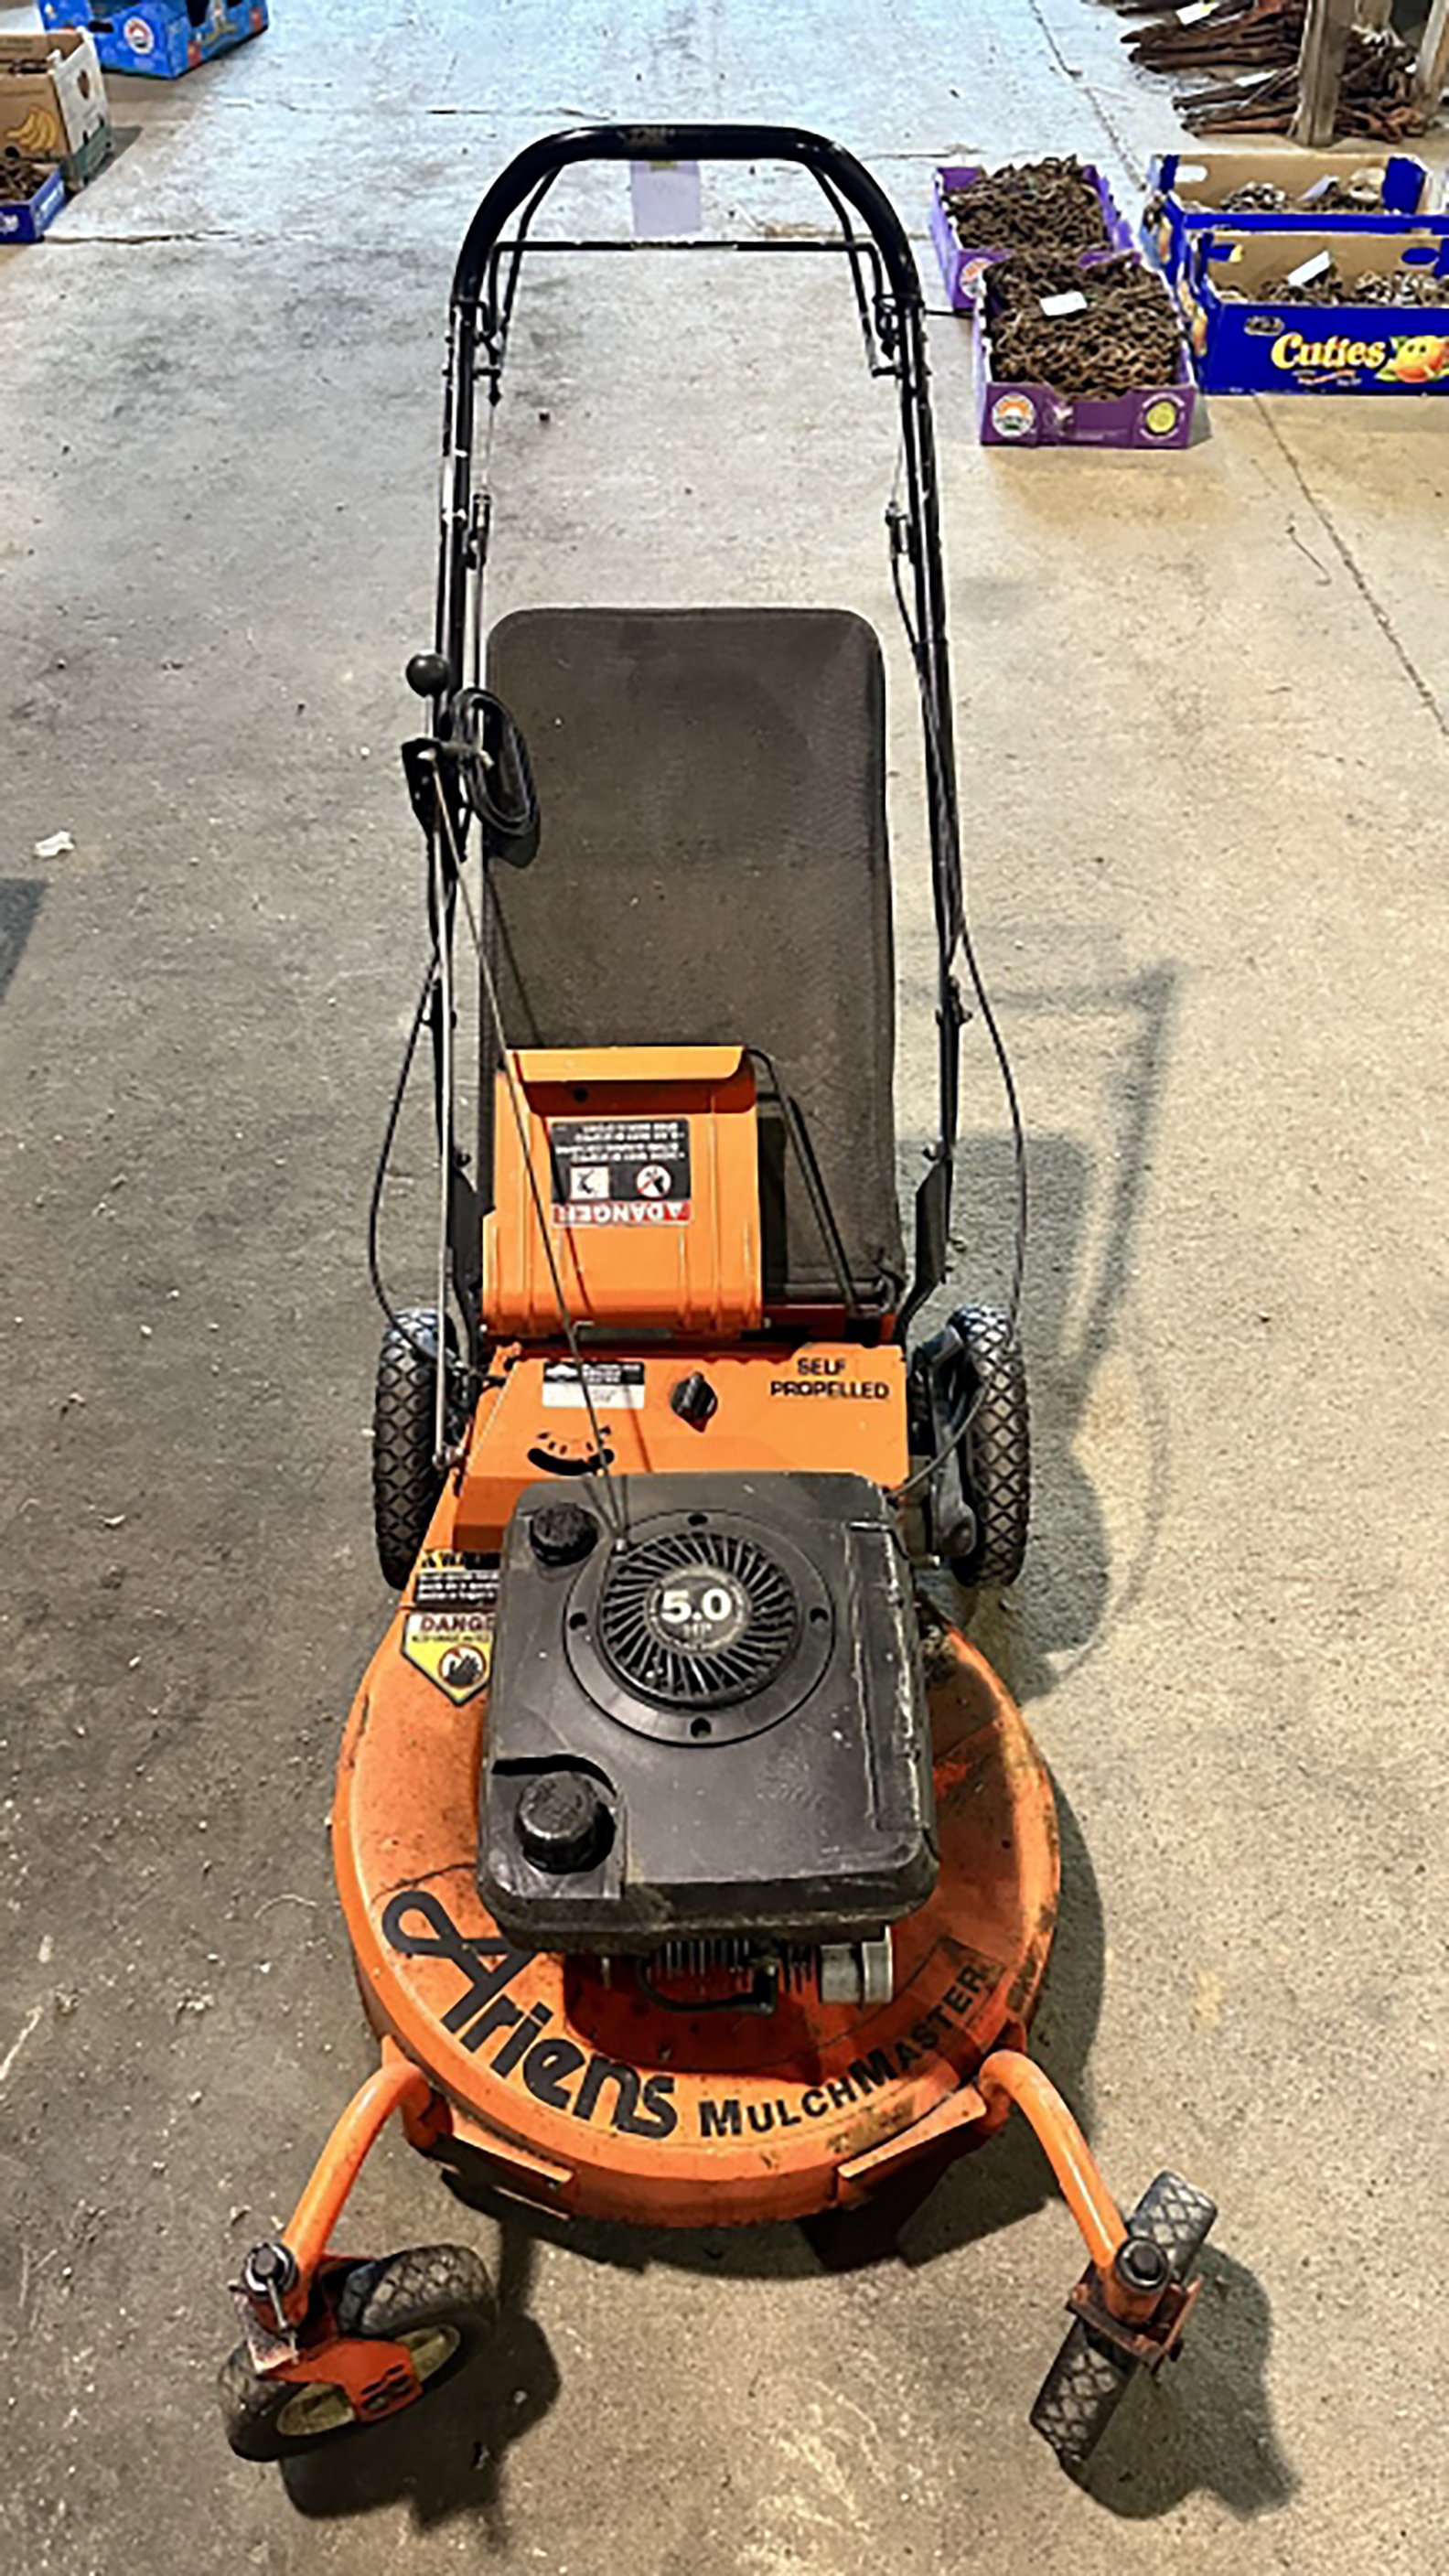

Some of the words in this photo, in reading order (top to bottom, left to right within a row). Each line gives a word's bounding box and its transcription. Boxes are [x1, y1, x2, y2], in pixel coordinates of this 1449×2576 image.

[1271, 331, 1386, 370] Cuties
[559, 1203, 665, 1223] DANGER
[797, 1357, 846, 1377] SELF
[770, 1379, 890, 1400] PROPELLED
[660, 1587, 733, 1624] 5.0
[381, 1889, 679, 2139] Ariens
